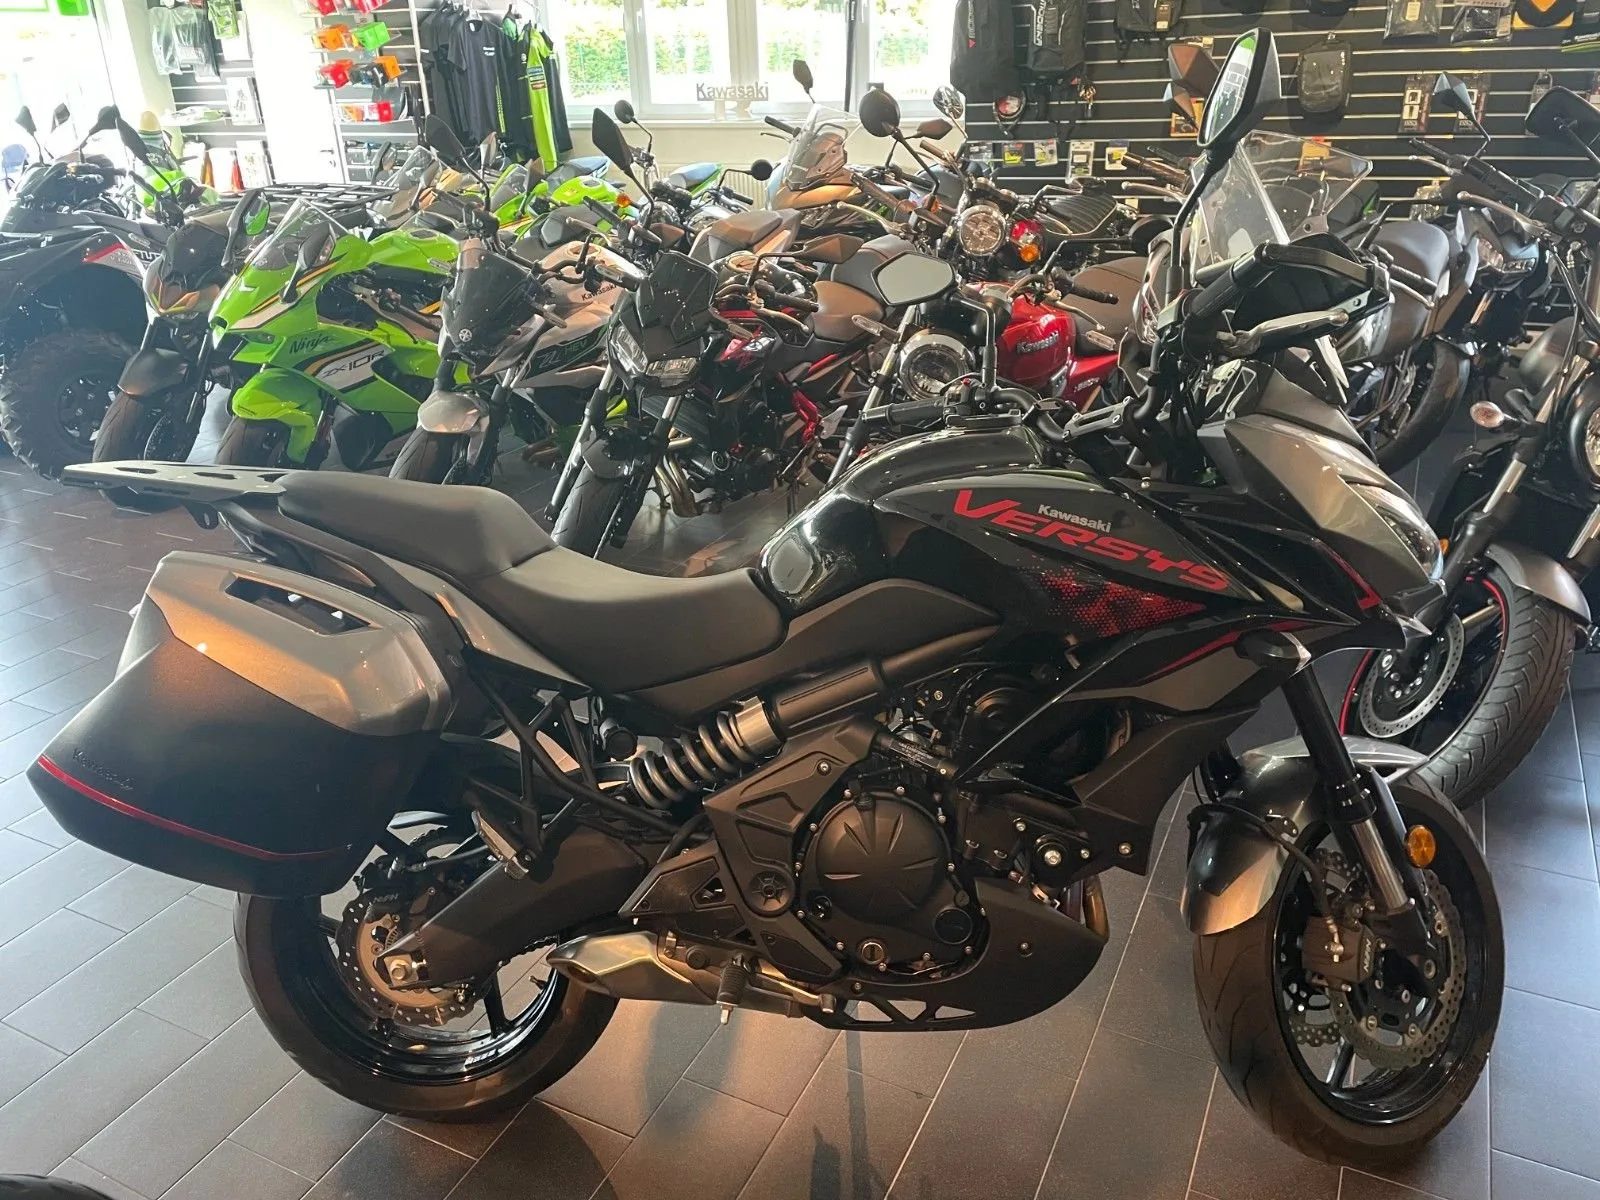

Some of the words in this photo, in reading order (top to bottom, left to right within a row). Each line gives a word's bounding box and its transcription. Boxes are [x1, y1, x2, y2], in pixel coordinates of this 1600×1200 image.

[696, 81, 769, 101] Kawasaki
[289, 333, 336, 355] Ninja
[1038, 504, 1112, 533] Kawasaki
[953, 490, 1229, 591] VERSYS
